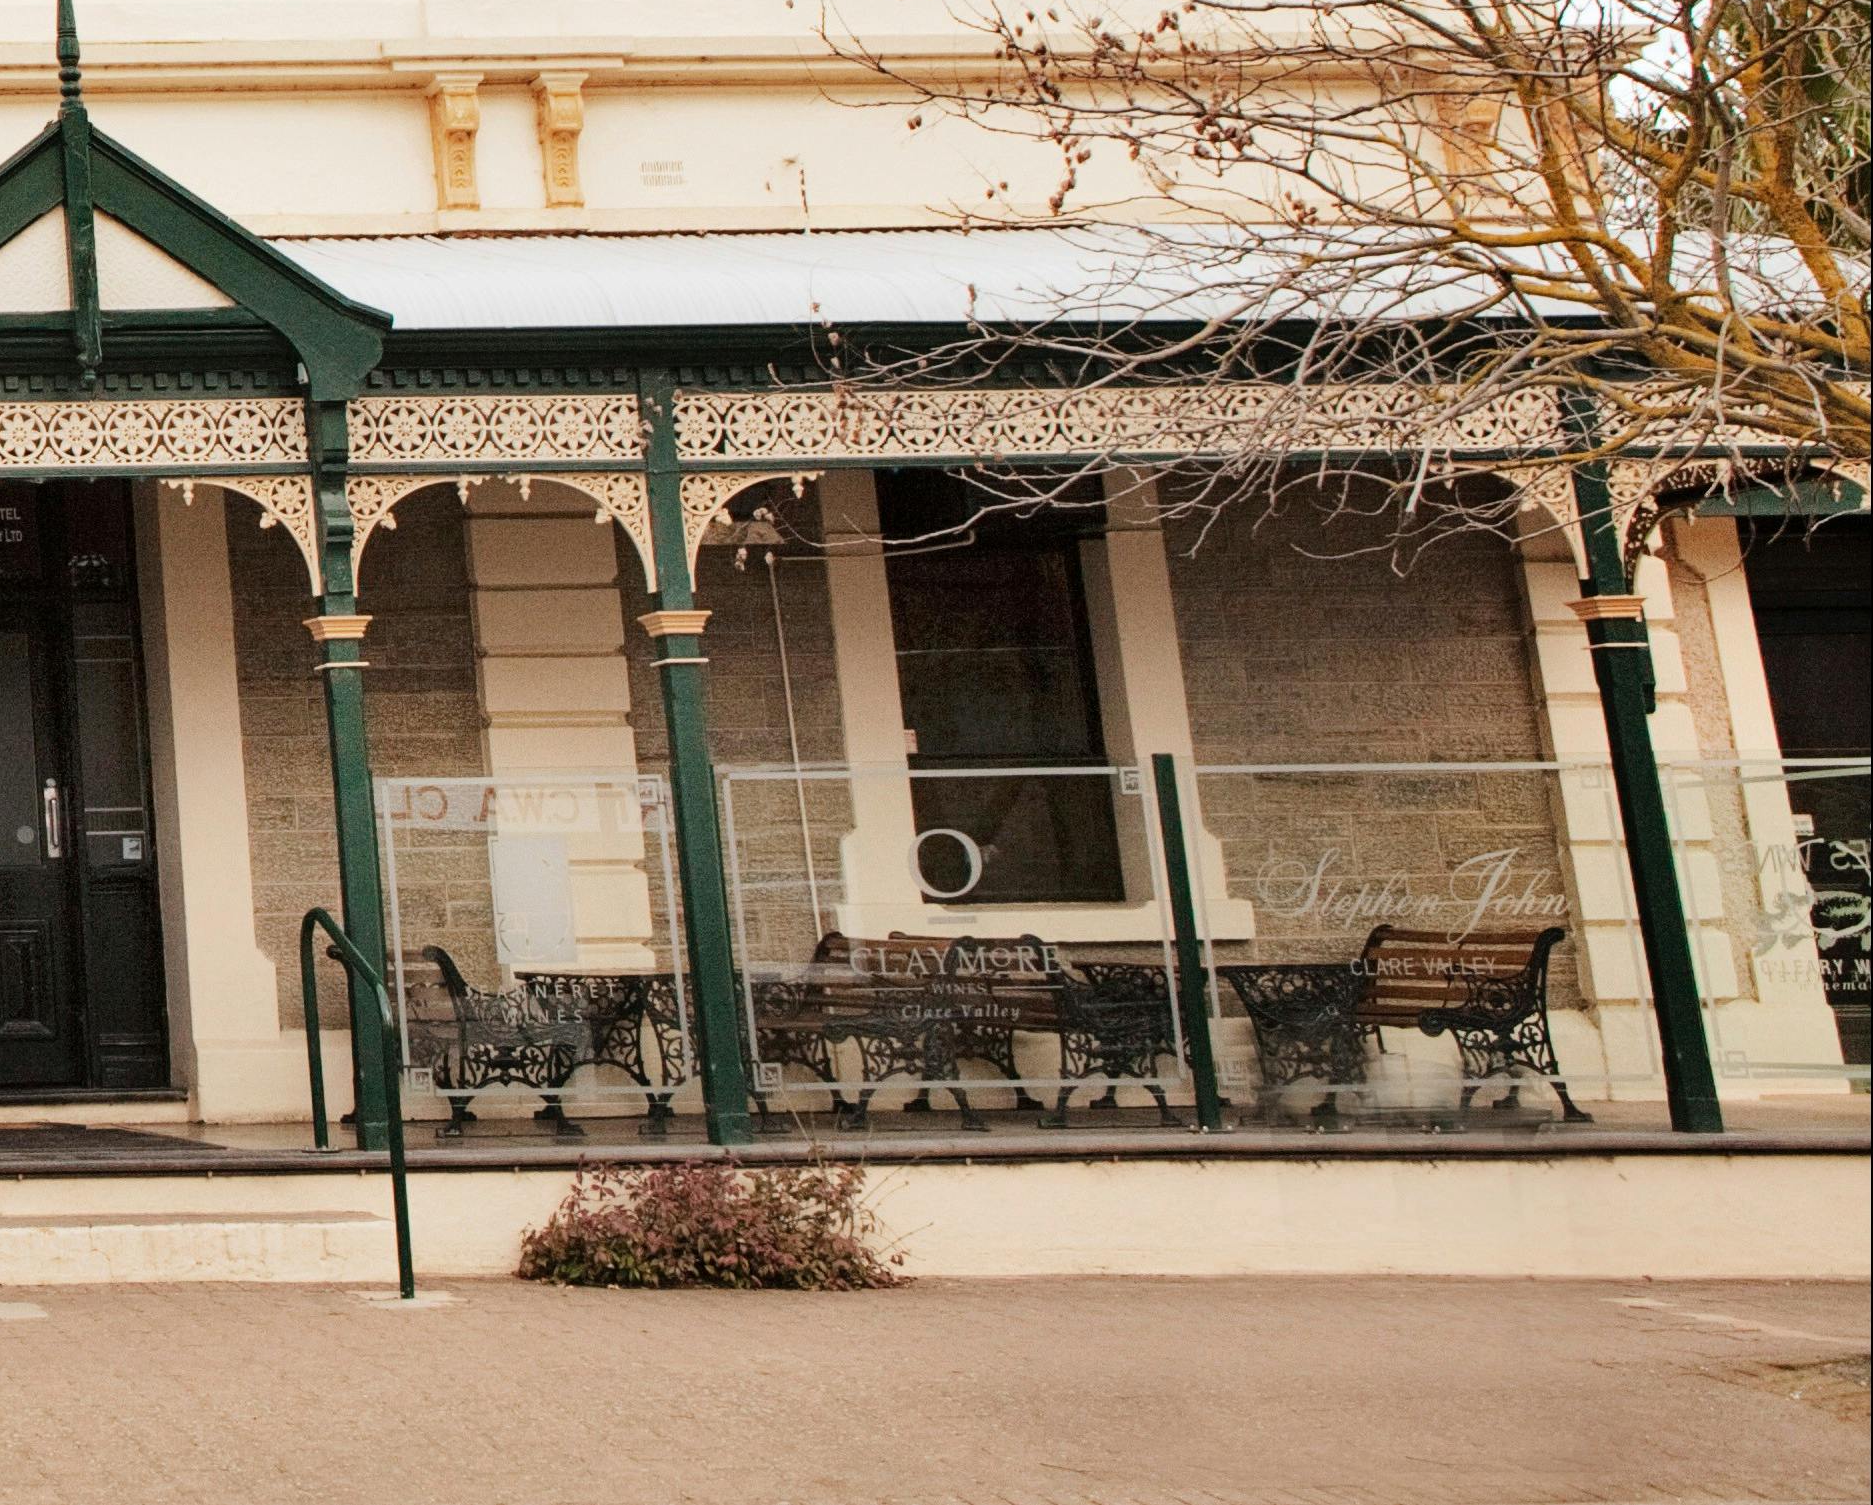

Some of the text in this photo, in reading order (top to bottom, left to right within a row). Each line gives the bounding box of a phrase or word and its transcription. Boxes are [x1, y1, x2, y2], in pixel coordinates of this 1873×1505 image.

[1256, 846, 1571, 945] Stephen John
[851, 945, 1064, 976] CLAYMORE
[1350, 956, 1497, 976] CLARE VALLEY
[902, 1003, 1021, 1022] Clare Valley
